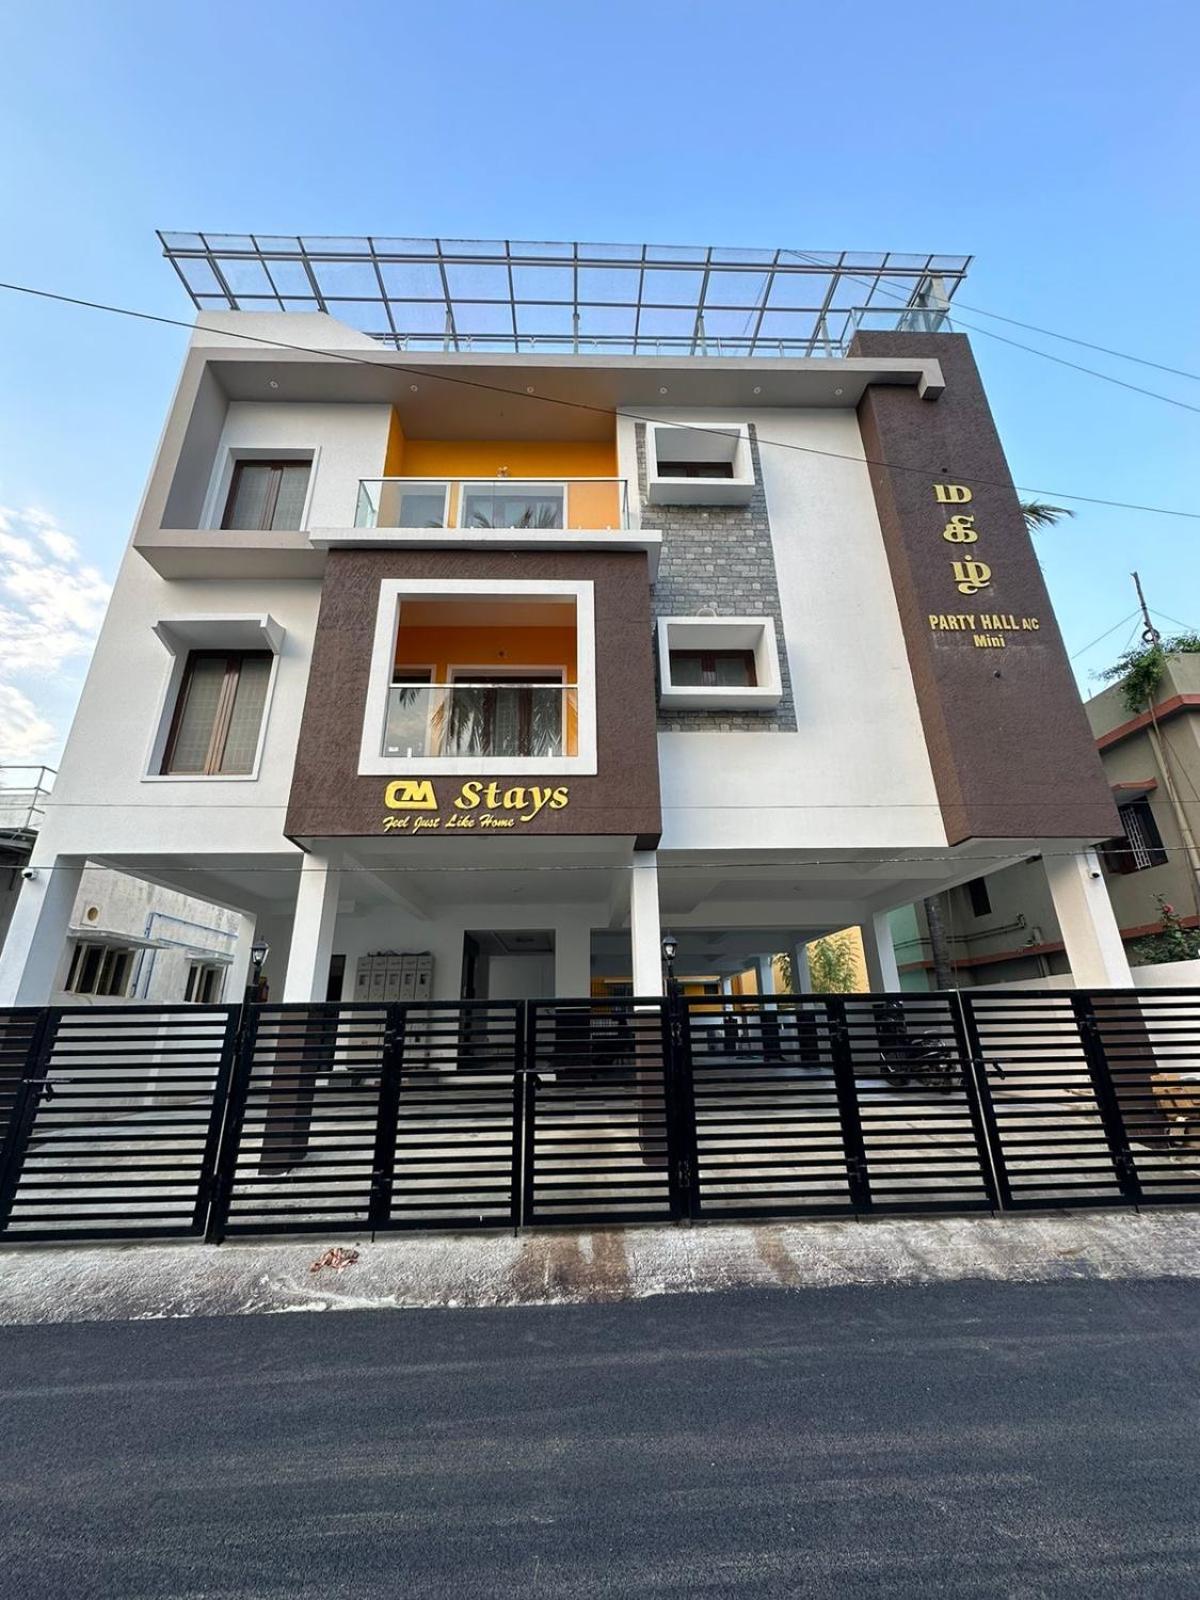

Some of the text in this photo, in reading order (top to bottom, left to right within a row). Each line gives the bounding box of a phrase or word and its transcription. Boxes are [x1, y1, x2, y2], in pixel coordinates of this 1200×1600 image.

[929, 614, 1040, 631] PARTY HALL A/C
[973, 634, 1006, 647] Mini
[454, 781, 569, 822] Stays
[383, 813, 514, 833] Feel Just Like Home
